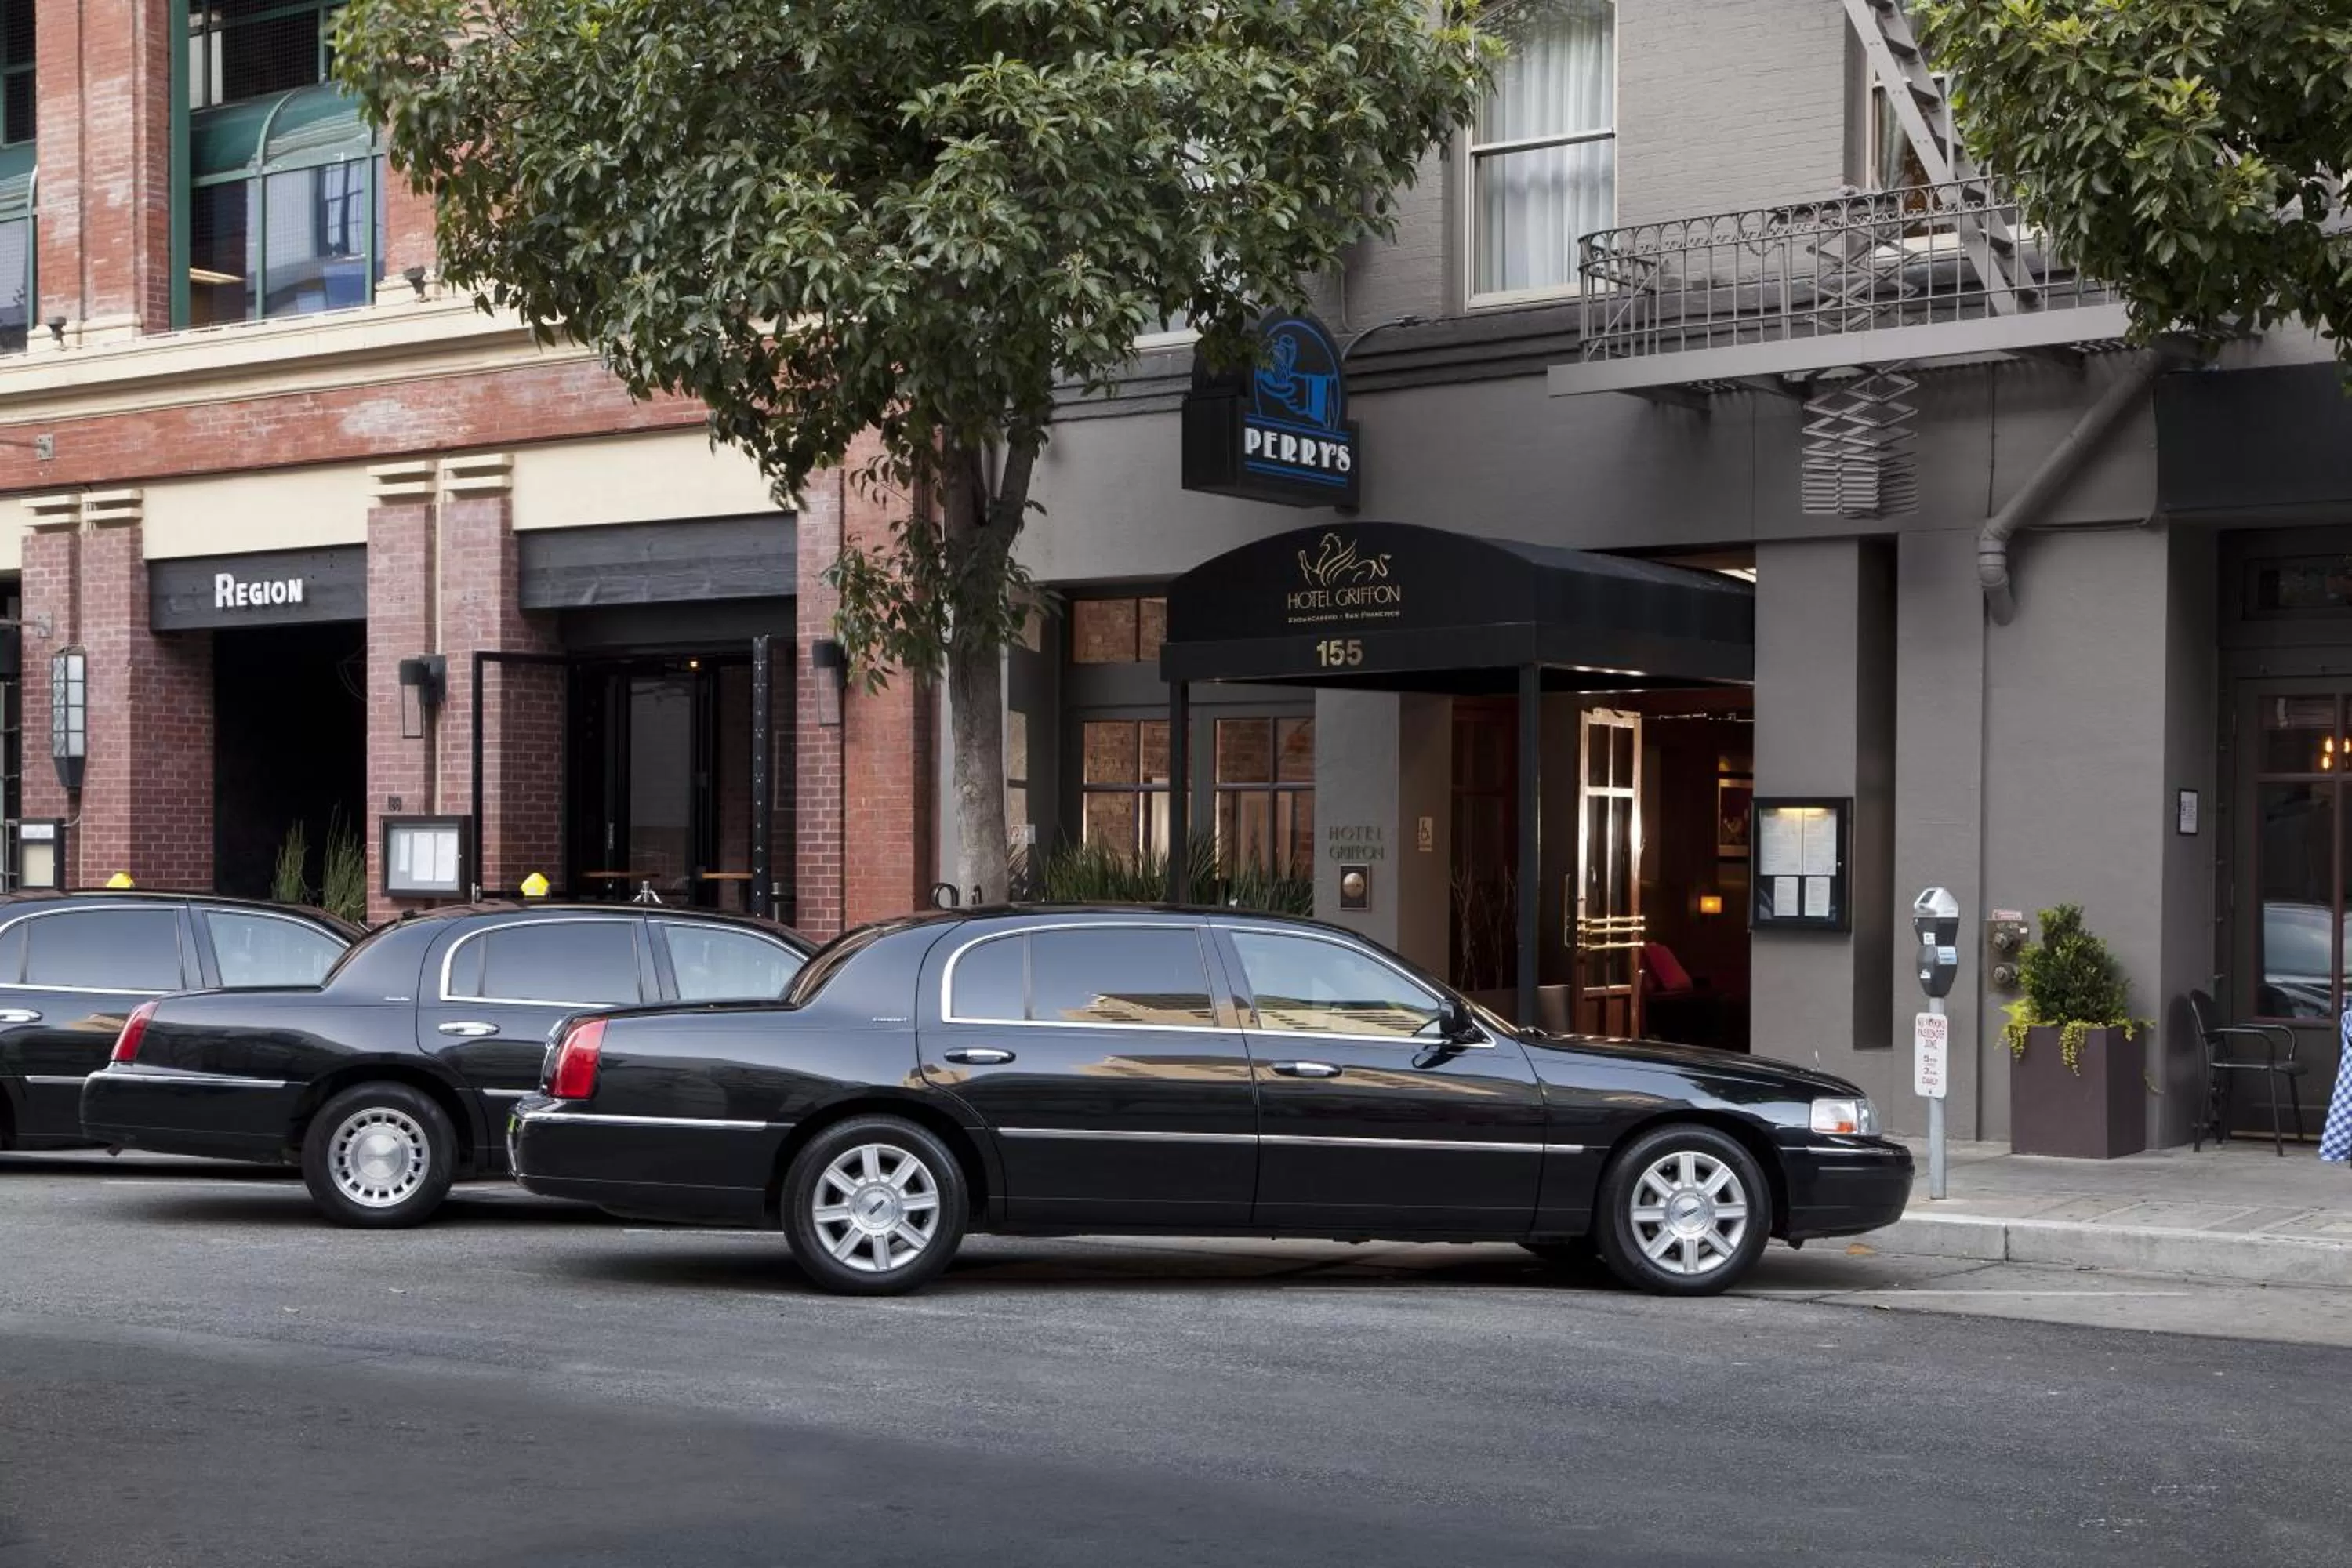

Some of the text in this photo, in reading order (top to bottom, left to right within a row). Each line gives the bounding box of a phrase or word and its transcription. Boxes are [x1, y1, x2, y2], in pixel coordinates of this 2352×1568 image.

[1244, 427, 1351, 472] PERRY'S
[216, 573, 303, 608] REGION
[1287, 585, 1402, 611] HOTEL GRIFFON
[1316, 639, 1363, 667] 155
[1329, 826, 1383, 841] HOTEL
[1329, 846, 1385, 860] GRIFFON
